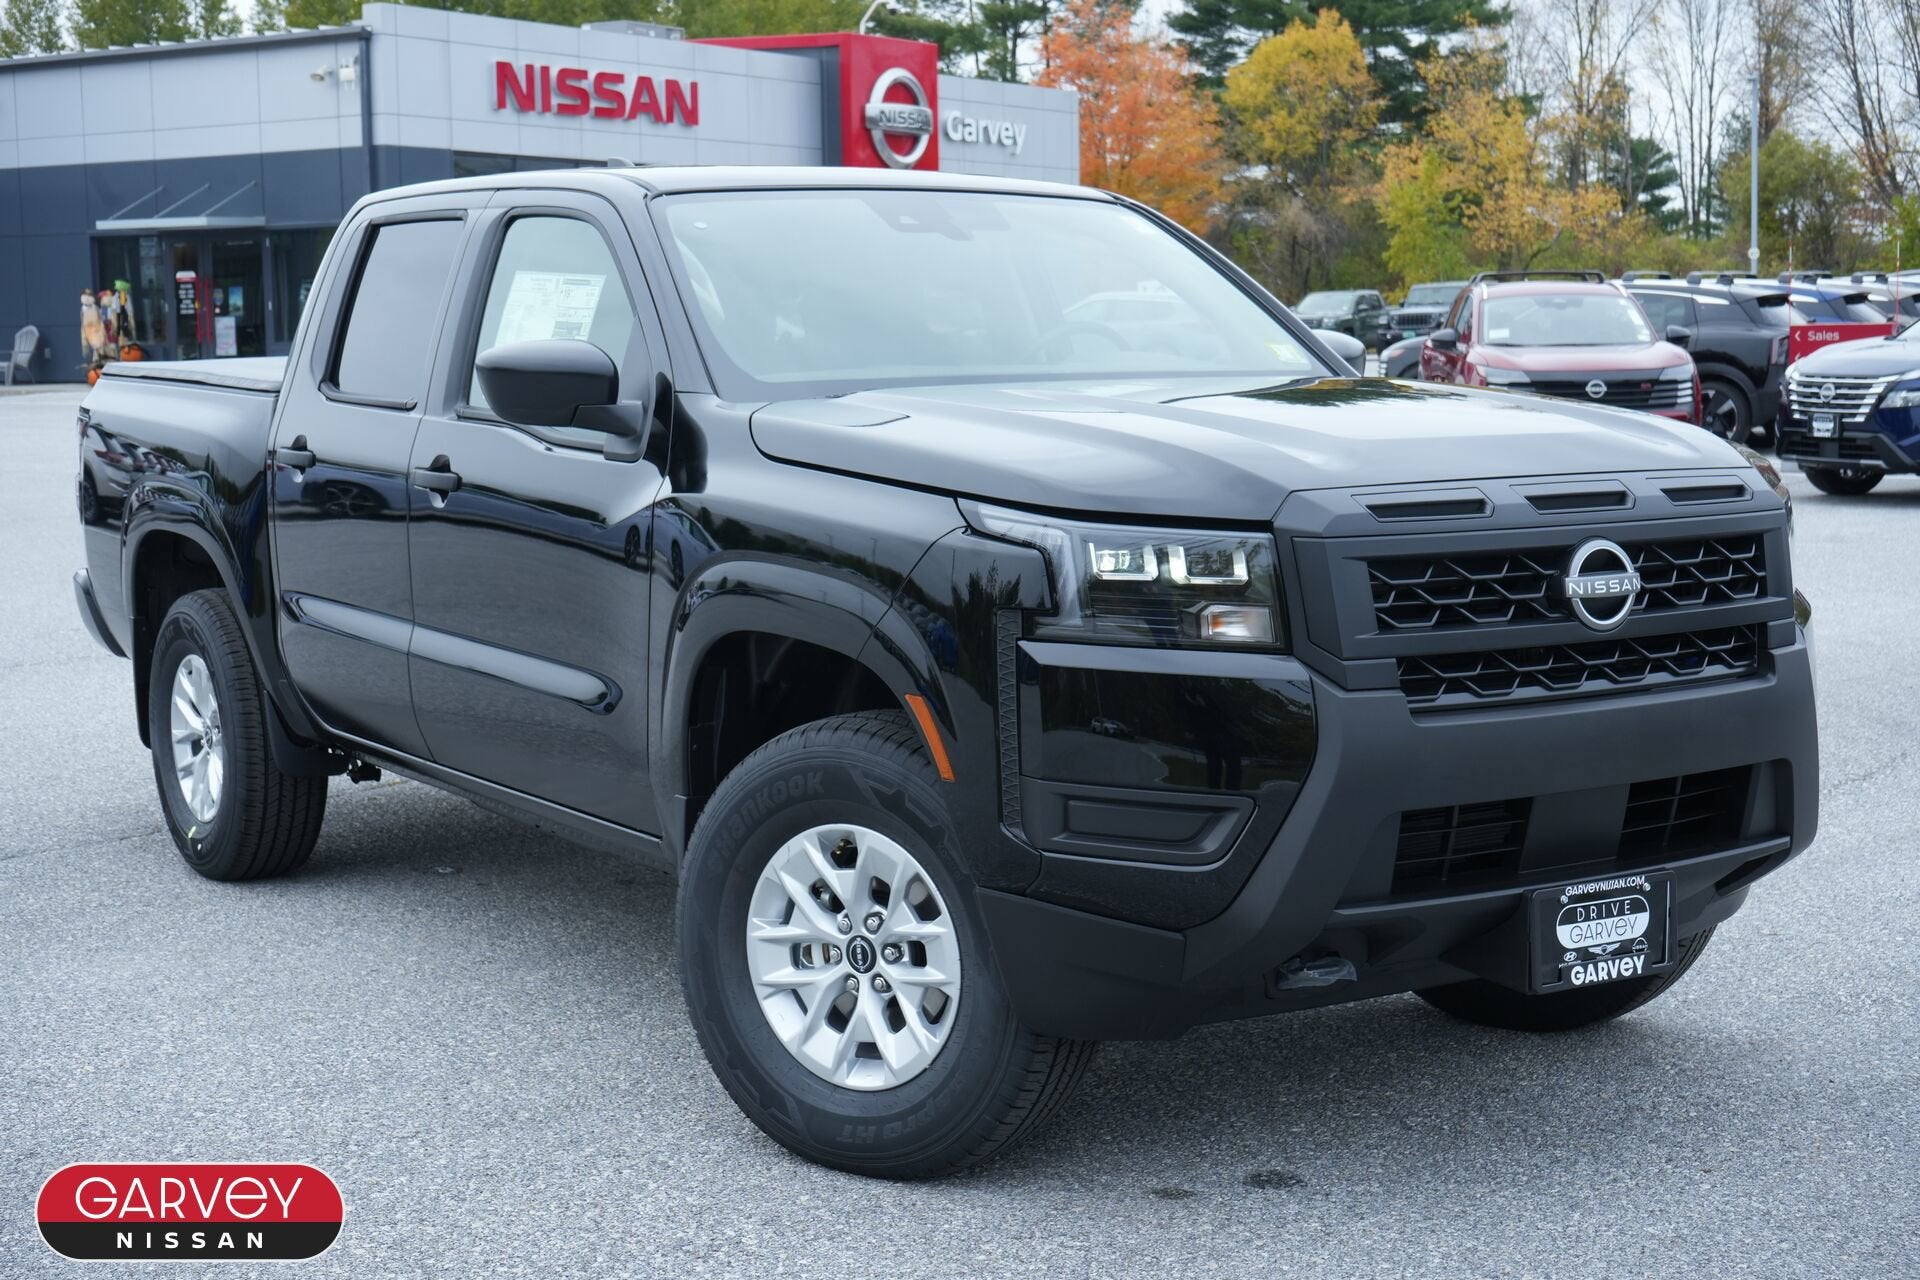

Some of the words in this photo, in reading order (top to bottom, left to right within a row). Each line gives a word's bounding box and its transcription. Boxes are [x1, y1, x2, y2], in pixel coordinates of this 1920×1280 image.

[495, 60, 699, 126] NISSAN
[946, 110, 1028, 156] Garvey
[1807, 330, 1840, 341] Sales
[1568, 576, 1641, 596] NISSAN
[1577, 900, 1631, 922] DRIVE
[855, 937, 865, 972] NISSAN
